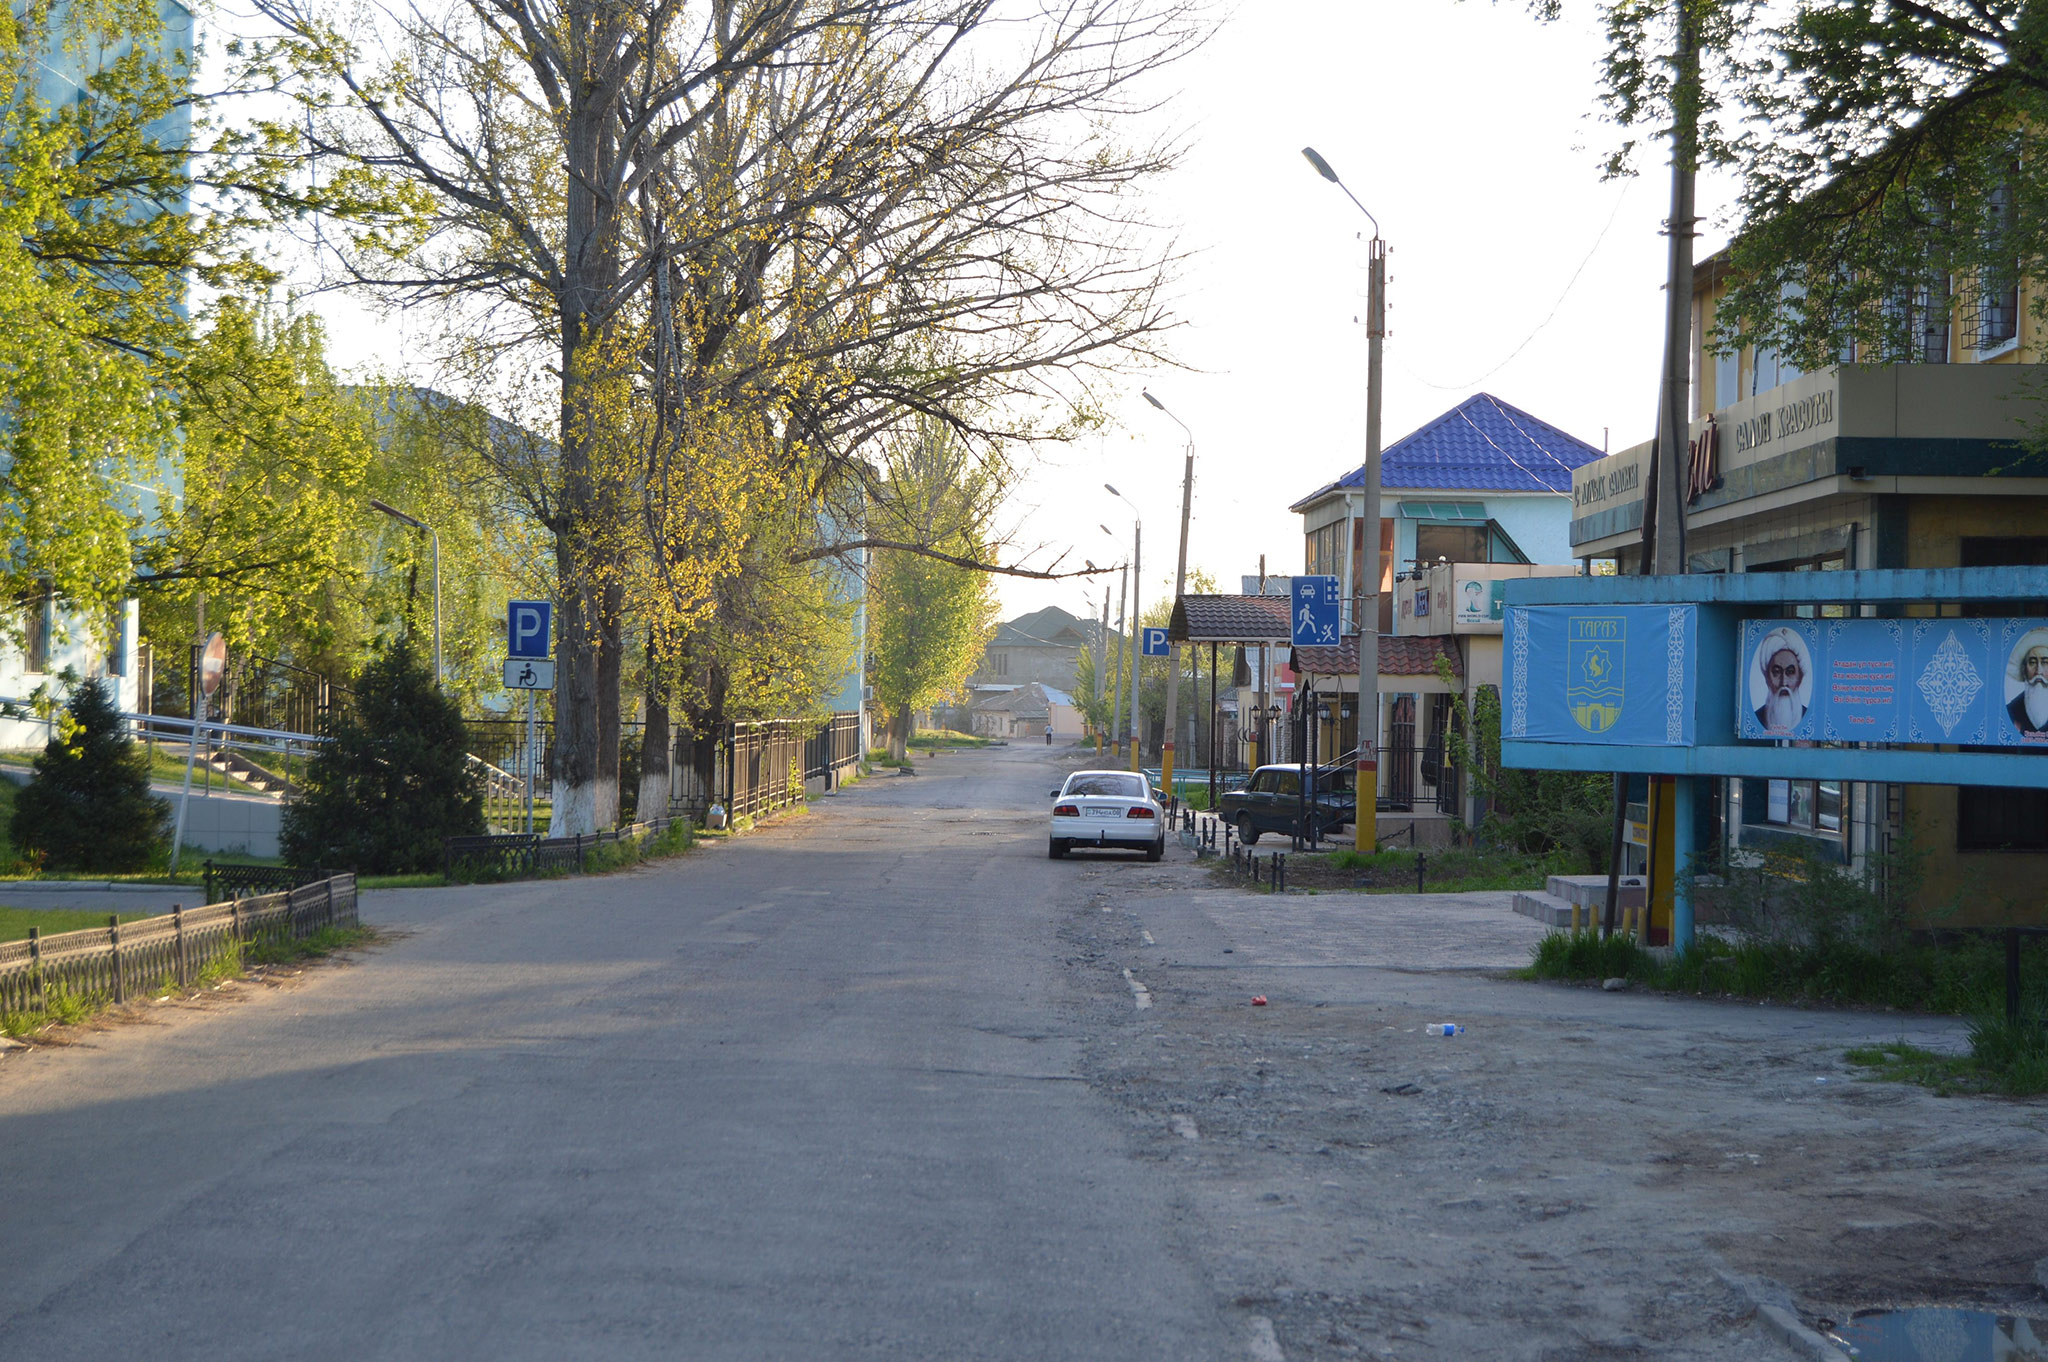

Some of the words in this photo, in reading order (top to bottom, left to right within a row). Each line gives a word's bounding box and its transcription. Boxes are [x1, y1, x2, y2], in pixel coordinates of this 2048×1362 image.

[1736, 411, 1771, 454] САЛОН
[1776, 389, 1833, 439] КРАСОТЫ
[515, 607, 542, 652] P
[1149, 630, 1166, 654] P
[1577, 620, 1618, 638] ТАРАЗ
